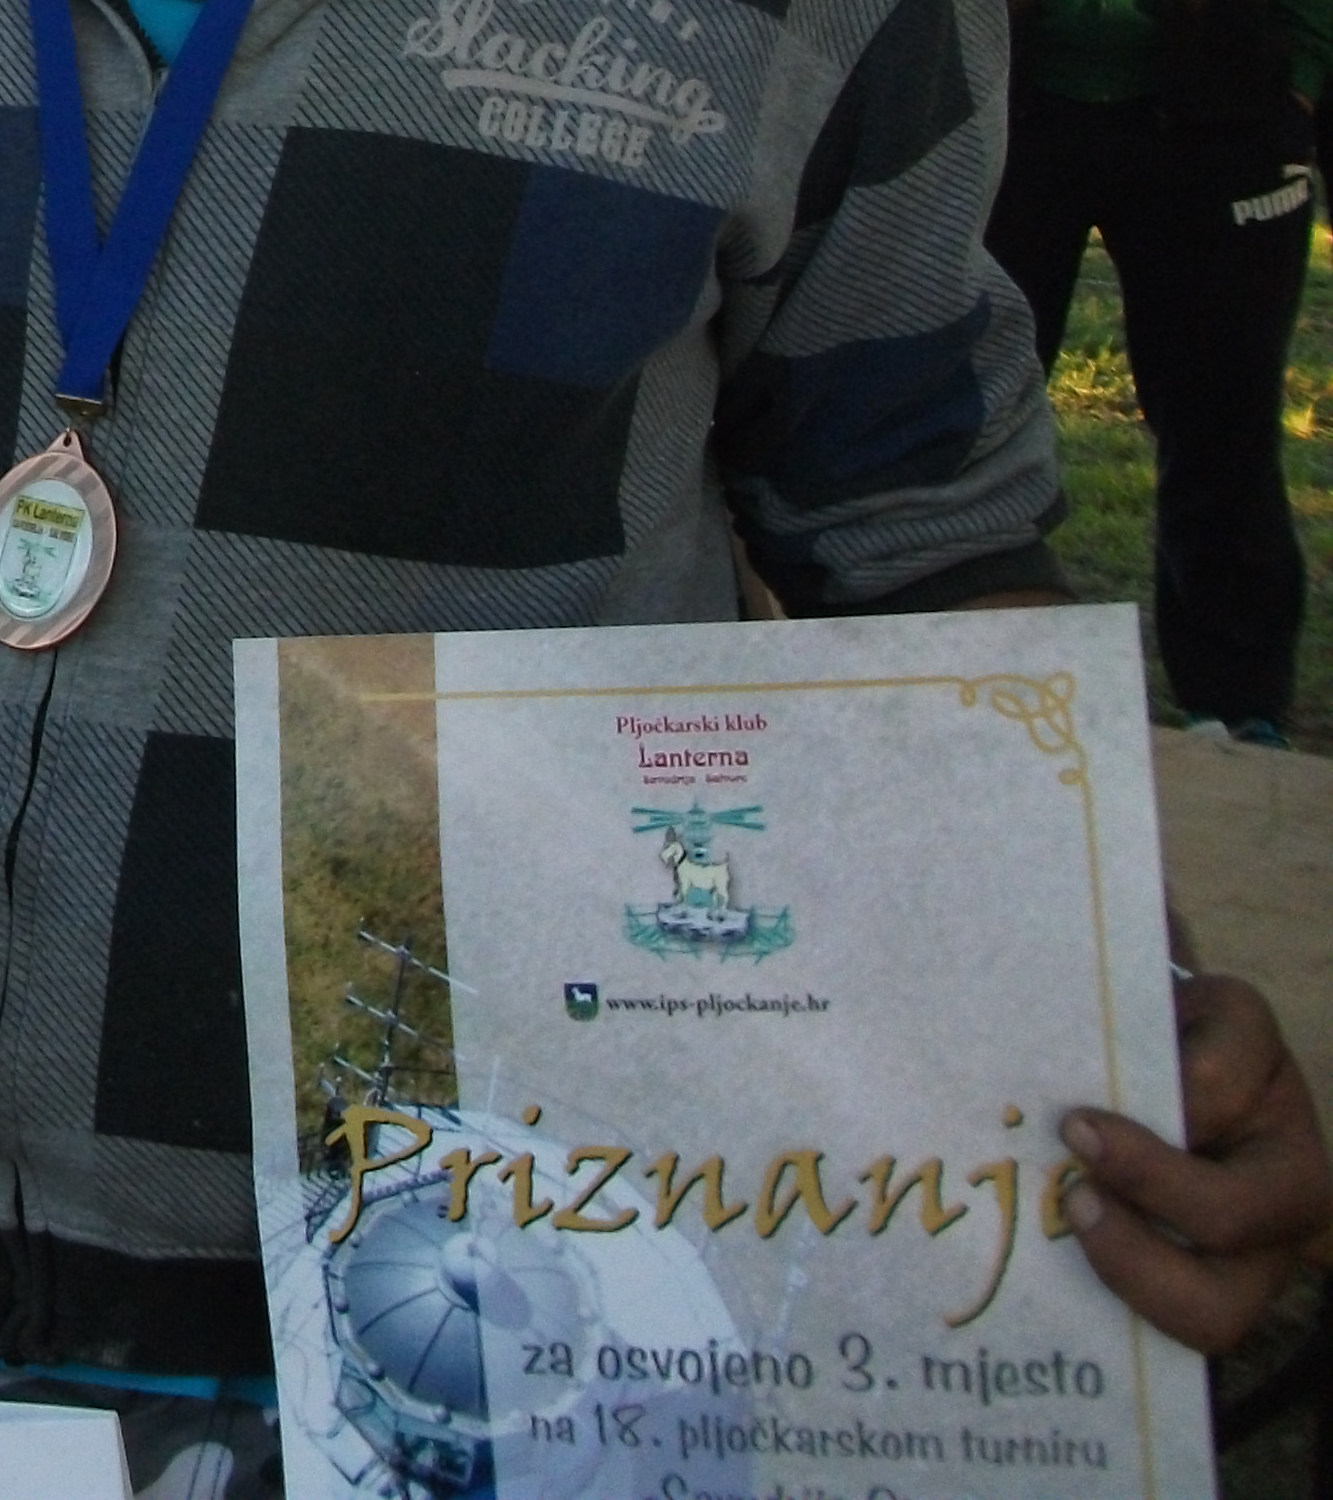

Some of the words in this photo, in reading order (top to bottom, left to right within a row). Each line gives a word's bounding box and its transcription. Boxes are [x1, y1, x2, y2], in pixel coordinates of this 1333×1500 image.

[479, 96, 653, 167] COLLEGE
[615, 715, 720, 739] Pljočkarski
[724, 713, 768, 733] klub
[637, 743, 750, 769] Lanterna
[605, 992, 831, 1018] www.ips-pljockanje.hr
[521, 1340, 575, 1377] za
[596, 1338, 814, 1397] osvojeno
[836, 1333, 899, 1393] 3.
[921, 1348, 1106, 1406] mjesto
[531, 1413, 576, 1446] na
[594, 1403, 663, 1447] 18.
[677, 1409, 946, 1461] pljočkarskom
[959, 1426, 1108, 1470] turniru
